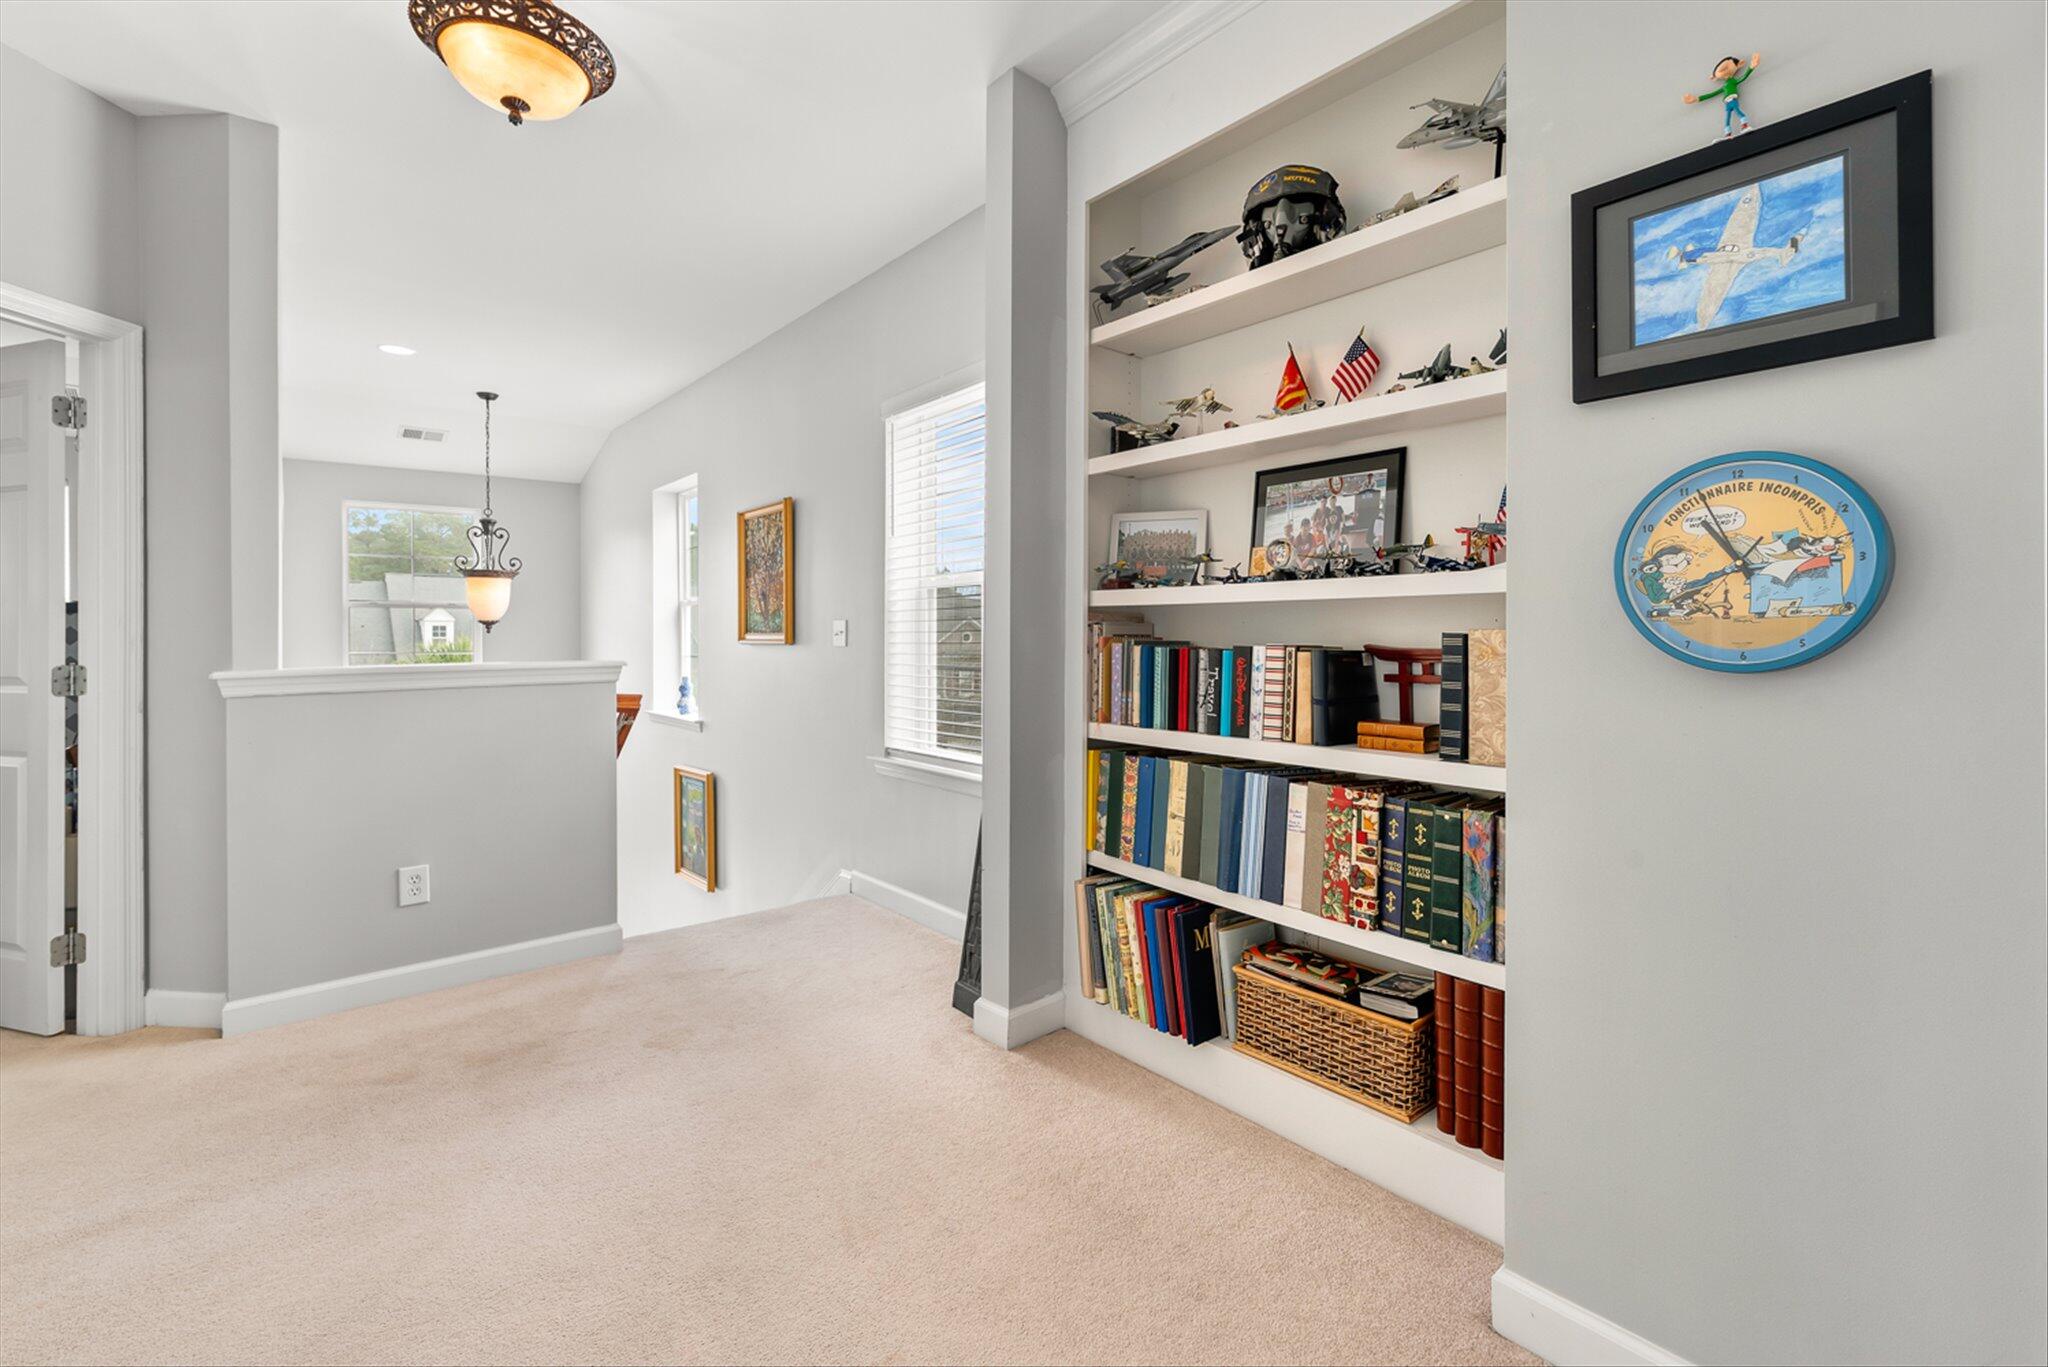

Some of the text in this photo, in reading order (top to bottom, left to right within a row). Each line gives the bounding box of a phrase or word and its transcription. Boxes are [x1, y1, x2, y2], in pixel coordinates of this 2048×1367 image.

[1732, 469, 1745, 479] 12
[1680, 487, 1690, 496] 11
[1664, 481, 1754, 527] FONCTINNAIRE
[1759, 481, 1826, 515] INCOMPRIS
[1841, 503, 1849, 513] 2
[1643, 524, 1654, 533] 10
[1859, 552, 1867, 561] 3
[1631, 568, 1638, 576] 9
[1685, 640, 1691, 649] 7
[1799, 638, 1806, 648] 5
[1739, 650, 1748, 661] 6
[1205, 667, 1219, 717] Travel
[1408, 864, 1431, 874] PHOTO
[1408, 870, 1431, 880] ALBUM
